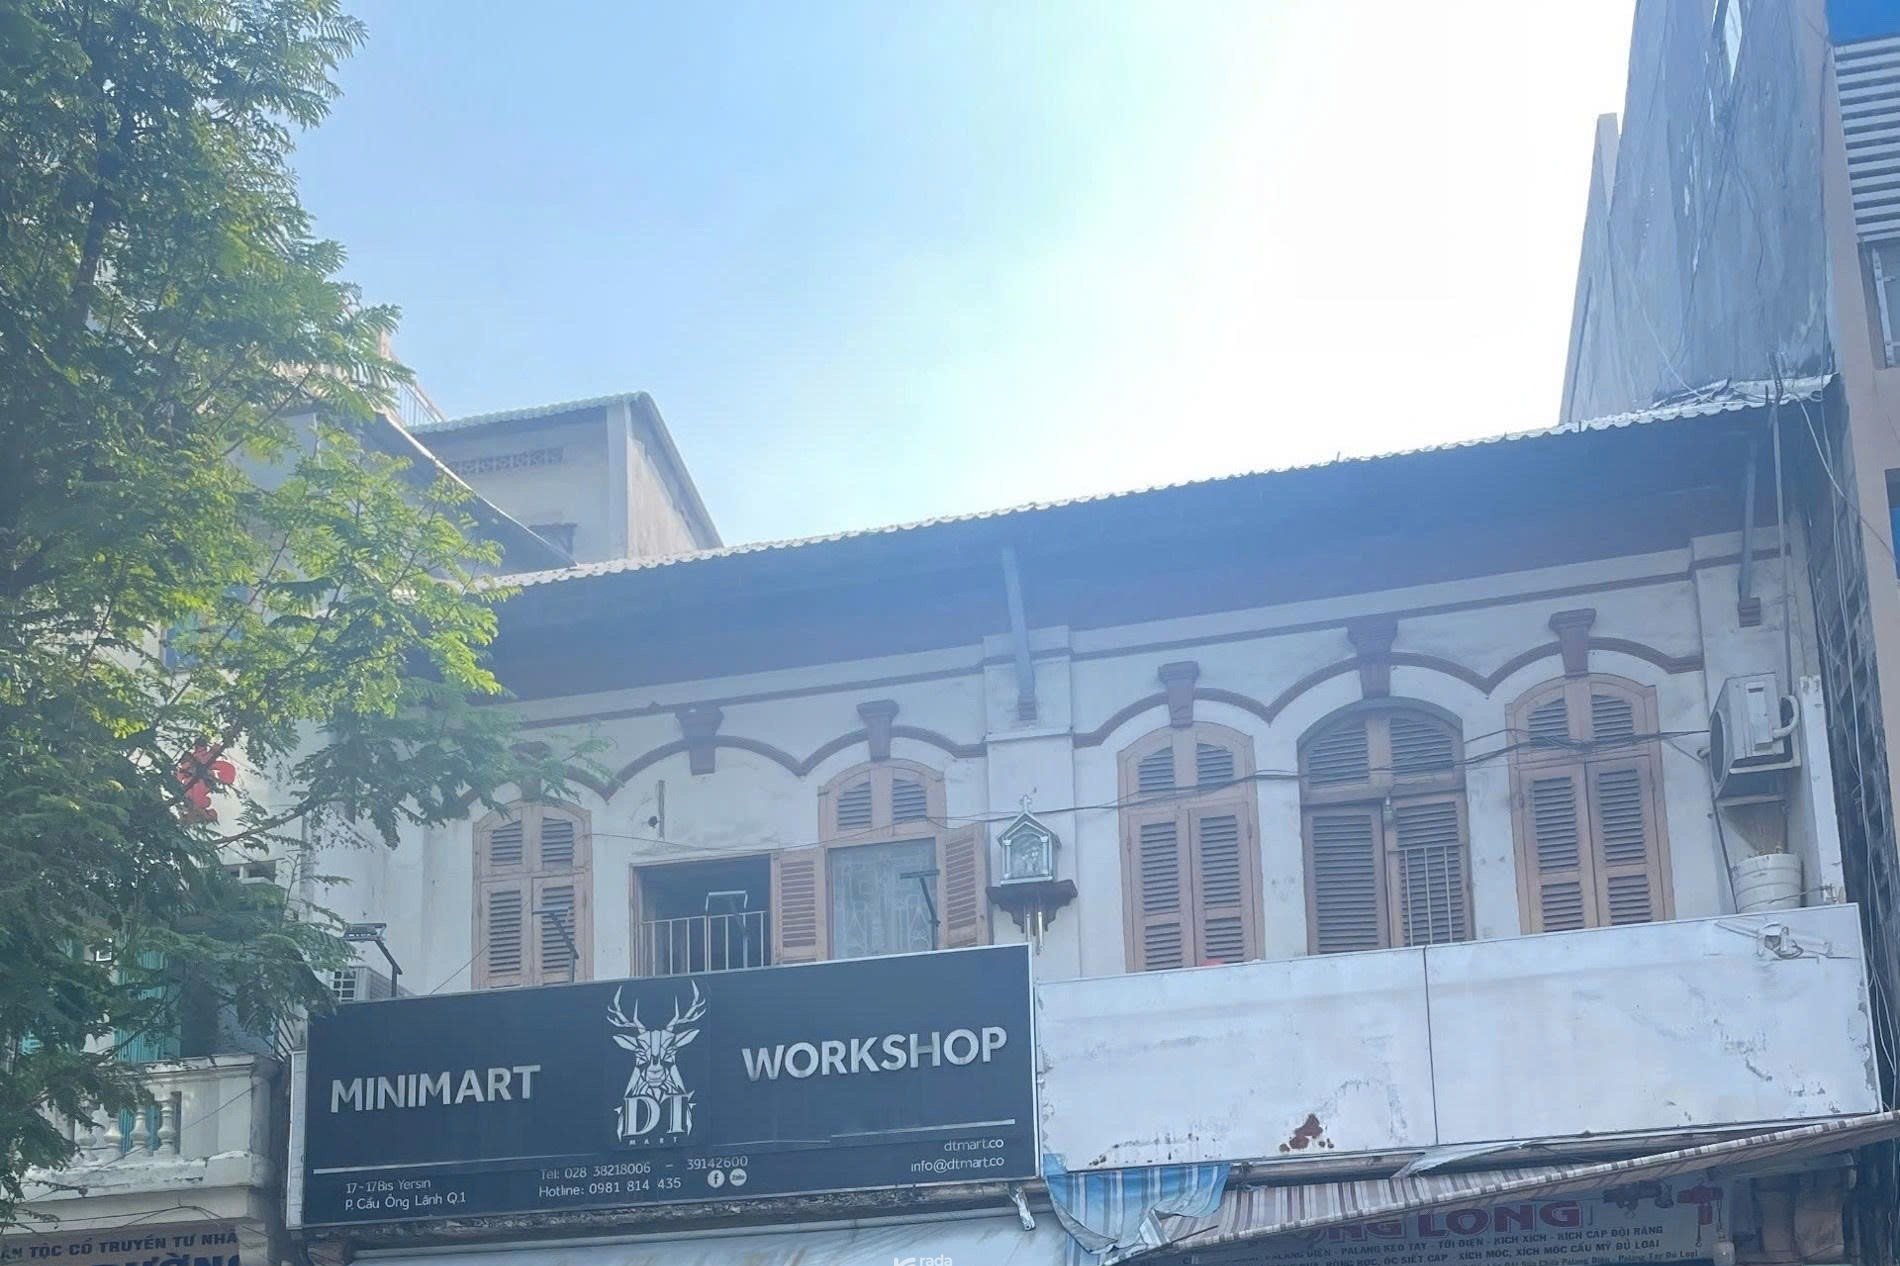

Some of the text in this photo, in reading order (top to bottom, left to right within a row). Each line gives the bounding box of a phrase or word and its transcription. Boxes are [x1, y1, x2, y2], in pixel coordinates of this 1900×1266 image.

[330, 1026, 1008, 1113] MINIMART WORKSHOP
[629, 1137, 678, 1146] MART
[540, 1168, 561, 1181] Tel:
[564, 1167, 587, 1179] 028
[593, 1163, 651, 1177] 38218006
[687, 1156, 748, 1170] 39142600
[399, 1178, 431, 1191] Yersin
[539, 1177, 681, 1198] Hotline: 0981 814 435
[385, 1193, 409, 1210] Ông
[415, 1193, 443, 1207] Lãnh
[1417, 1200, 1581, 1239] LONG
[29, 1242, 62, 1260] TỘC
[99, 1235, 166, 1253] TRUYỀN
[172, 1234, 196, 1248] TƯ
[201, 1230, 238, 1245] NHÂ
